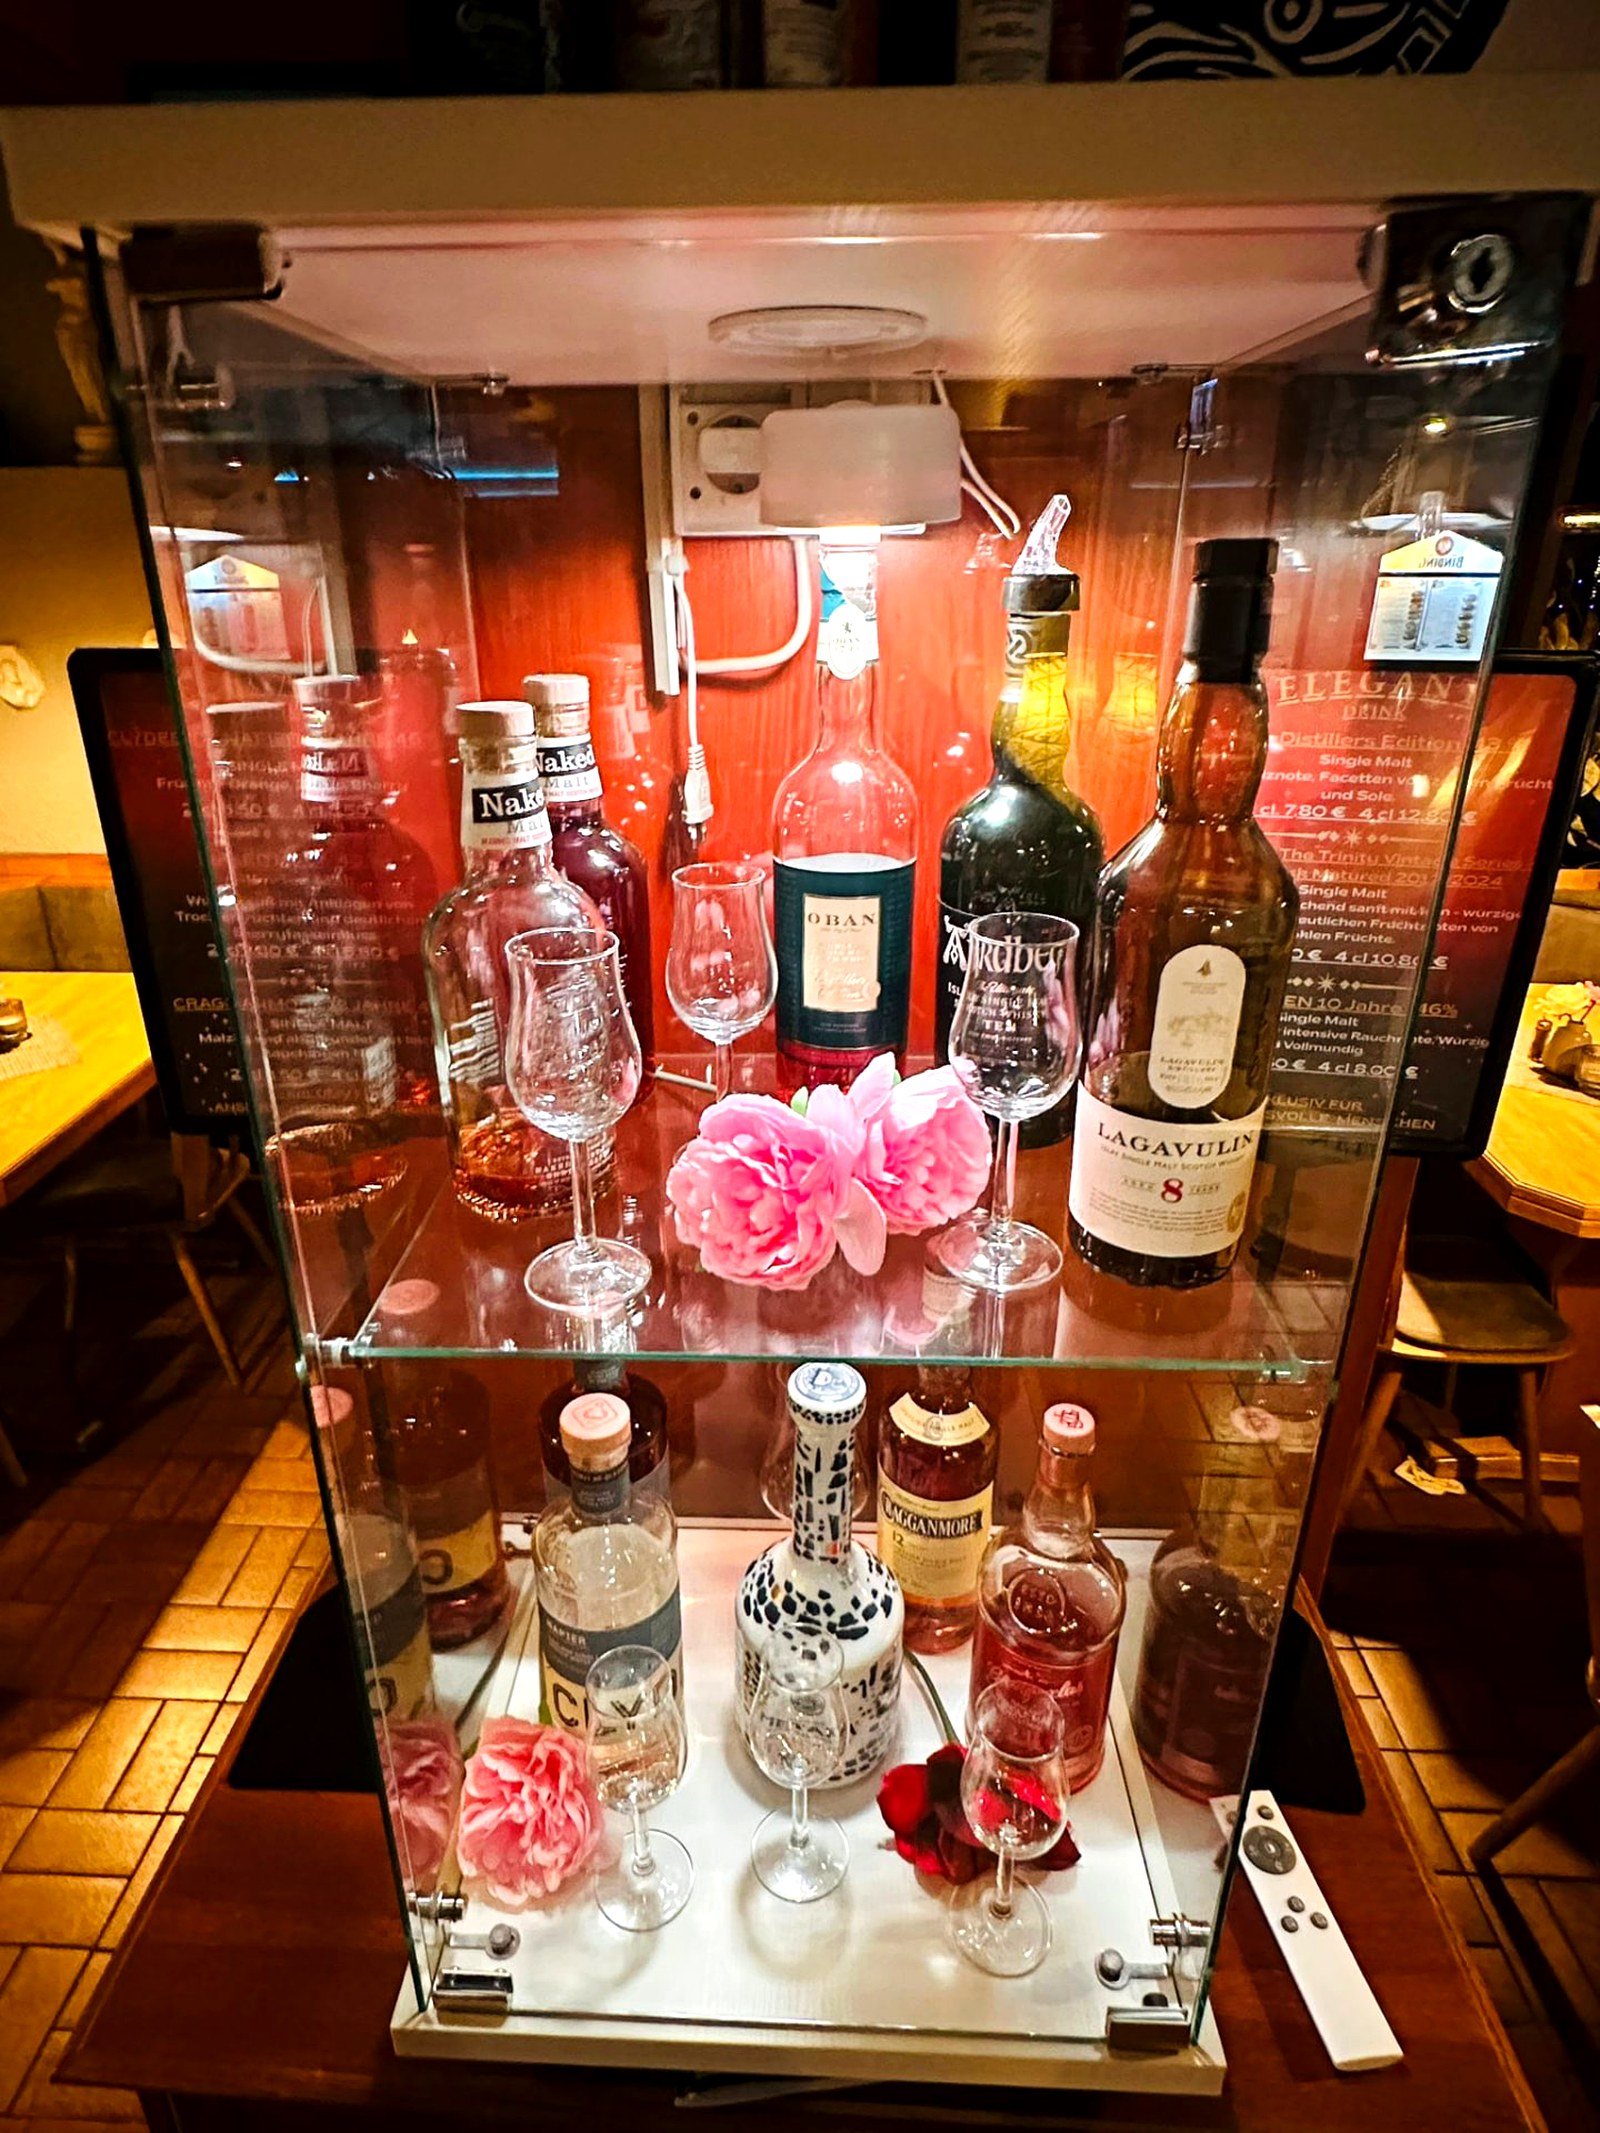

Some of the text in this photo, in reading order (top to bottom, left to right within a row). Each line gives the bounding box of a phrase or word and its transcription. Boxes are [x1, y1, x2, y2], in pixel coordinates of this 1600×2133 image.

[1280, 731, 1375, 747] Distillers
[1381, 733, 1460, 751] Edition
[1319, 754, 1412, 769] Single Malt
[1319, 771, 1392, 785] Facetten
[1321, 789, 1354, 801] und
[1330, 806, 1346, 819] €
[1281, 847, 1314, 861] The
[1318, 849, 1378, 867] Trinity
[1298, 883, 1388, 899] Single Malt
[1349, 903, 1387, 914] sanft
[807, 912, 877, 927] OBAN
[1471, 924, 1499, 933] von
[1307, 949, 1322, 961] €
[1334, 950, 1347, 962] 4
[1352, 952, 1368, 964] cl
[1433, 955, 1449, 967] €
[1316, 997, 1341, 1011] 10
[1345, 999, 1405, 1015] Jahre
[1324, 1015, 1359, 1027] Malt
[1283, 1027, 1348, 1040] intensive
[1284, 1041, 1364, 1057] Vollmundig
[1291, 1058, 1307, 1071] €
[1318, 1060, 1331, 1072] 4
[1335, 1062, 1350, 1074] cl
[1404, 1065, 1419, 1077] €
[1097, 1122, 1255, 1159] LAGAVULIN
[1160, 1178, 1184, 1204] 8
